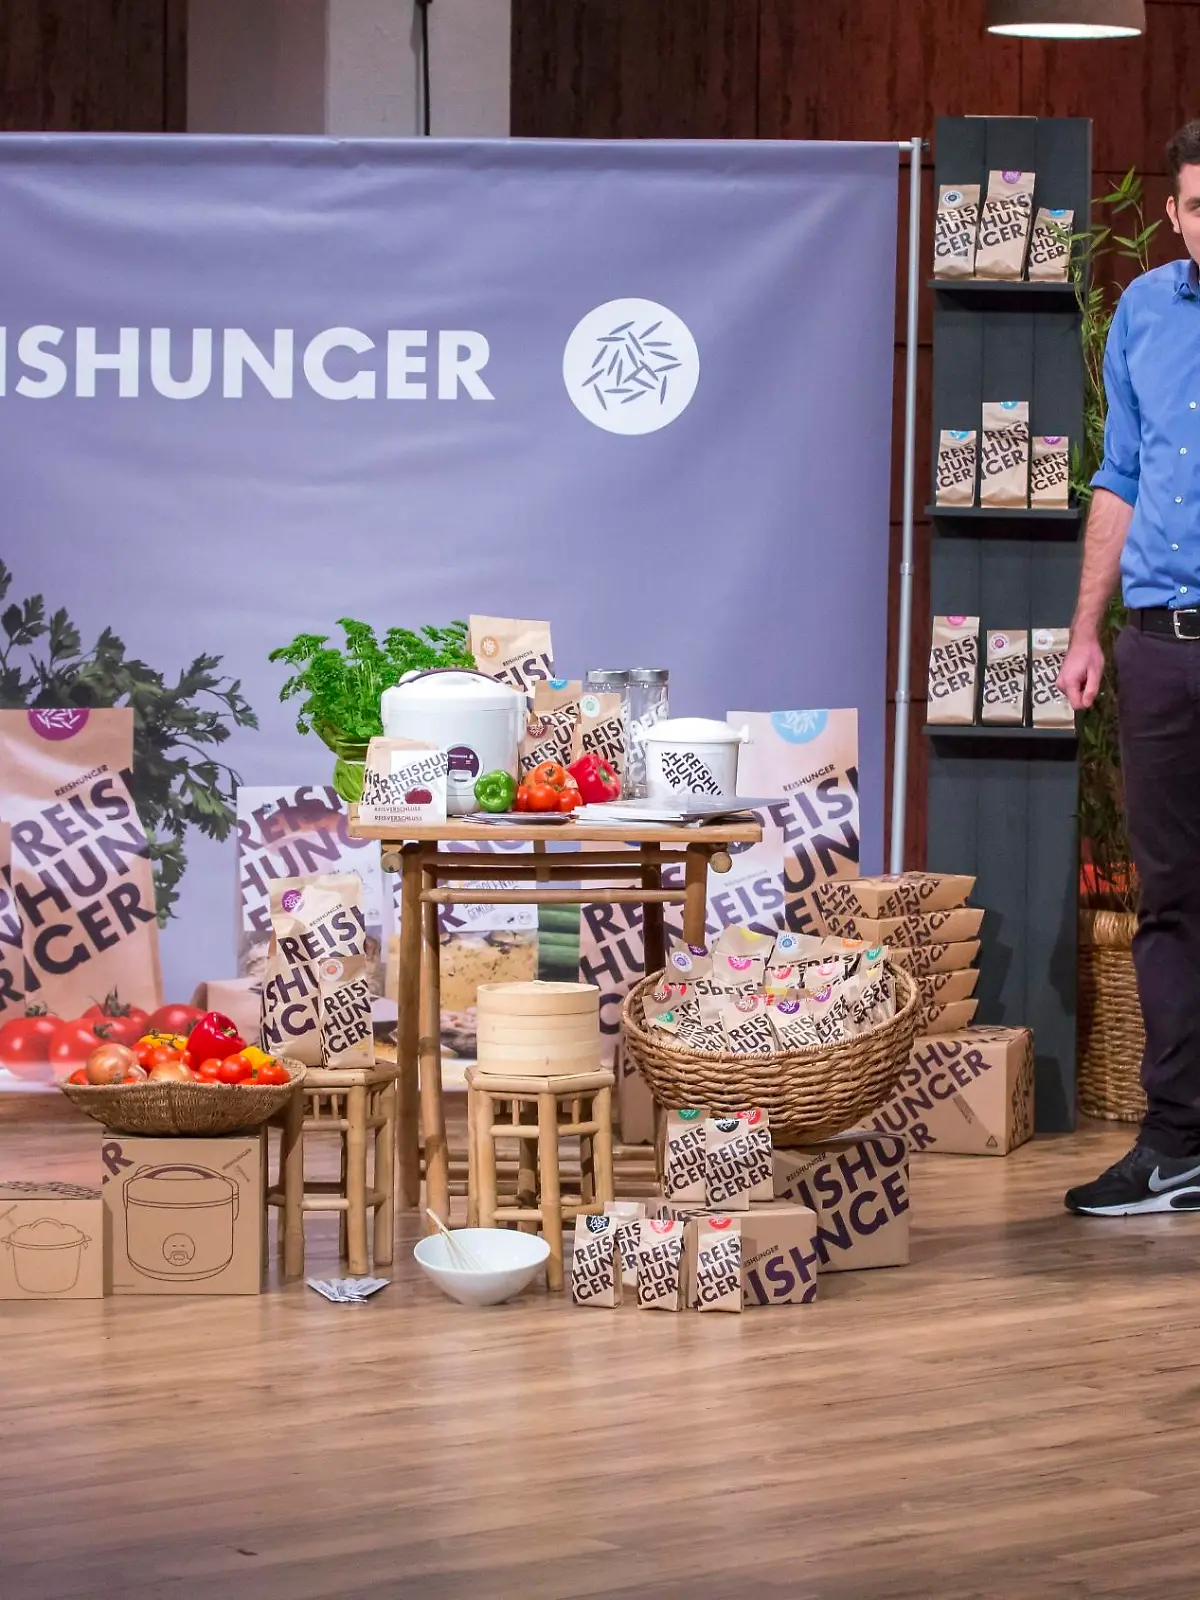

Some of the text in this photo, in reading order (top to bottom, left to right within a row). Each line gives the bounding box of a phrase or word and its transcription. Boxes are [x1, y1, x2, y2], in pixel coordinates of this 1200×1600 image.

[983, 223, 1025, 247] GER
[0, 324, 496, 400] SHUNGER
[982, 435, 1028, 460] HUN
[938, 455, 975, 475] HUN
[985, 450, 1027, 475] GER
[940, 468, 973, 487] GER
[1034, 471, 1067, 490] GER
[933, 638, 975, 663] REIS
[930, 652, 976, 681] HUN
[932, 671, 973, 698] GER
[984, 680, 1022, 704] GER
[54, 764, 108, 796] REISHUNGER
[783, 764, 835, 792] REISHUNGER
[12, 779, 130, 867] REIS
[15, 822, 150, 927] HUN
[34, 882, 157, 975] GER
[277, 911, 357, 965] REIS
[324, 982, 366, 1015] REIS
[324, 997, 372, 1036] HUN
[728, 1016, 768, 1041] REIS
[328, 1021, 372, 1054] GER
[669, 1128, 706, 1156] REIS
[707, 1139, 748, 1168] REIS
[706, 1158, 749, 1187] HUN
[785, 1151, 827, 1182] REISHUNGER
[710, 1176, 751, 1203] GER
[575, 1236, 613, 1264] REIS
[639, 1239, 680, 1267] REIS
[699, 1237, 740, 1268] REIS
[572, 1252, 614, 1284] HUN
[639, 1256, 679, 1286] HUN
[697, 1255, 741, 1287] HUN
[576, 1273, 614, 1300] GER
[641, 1276, 678, 1302] GER
[701, 1274, 740, 1303] GER
